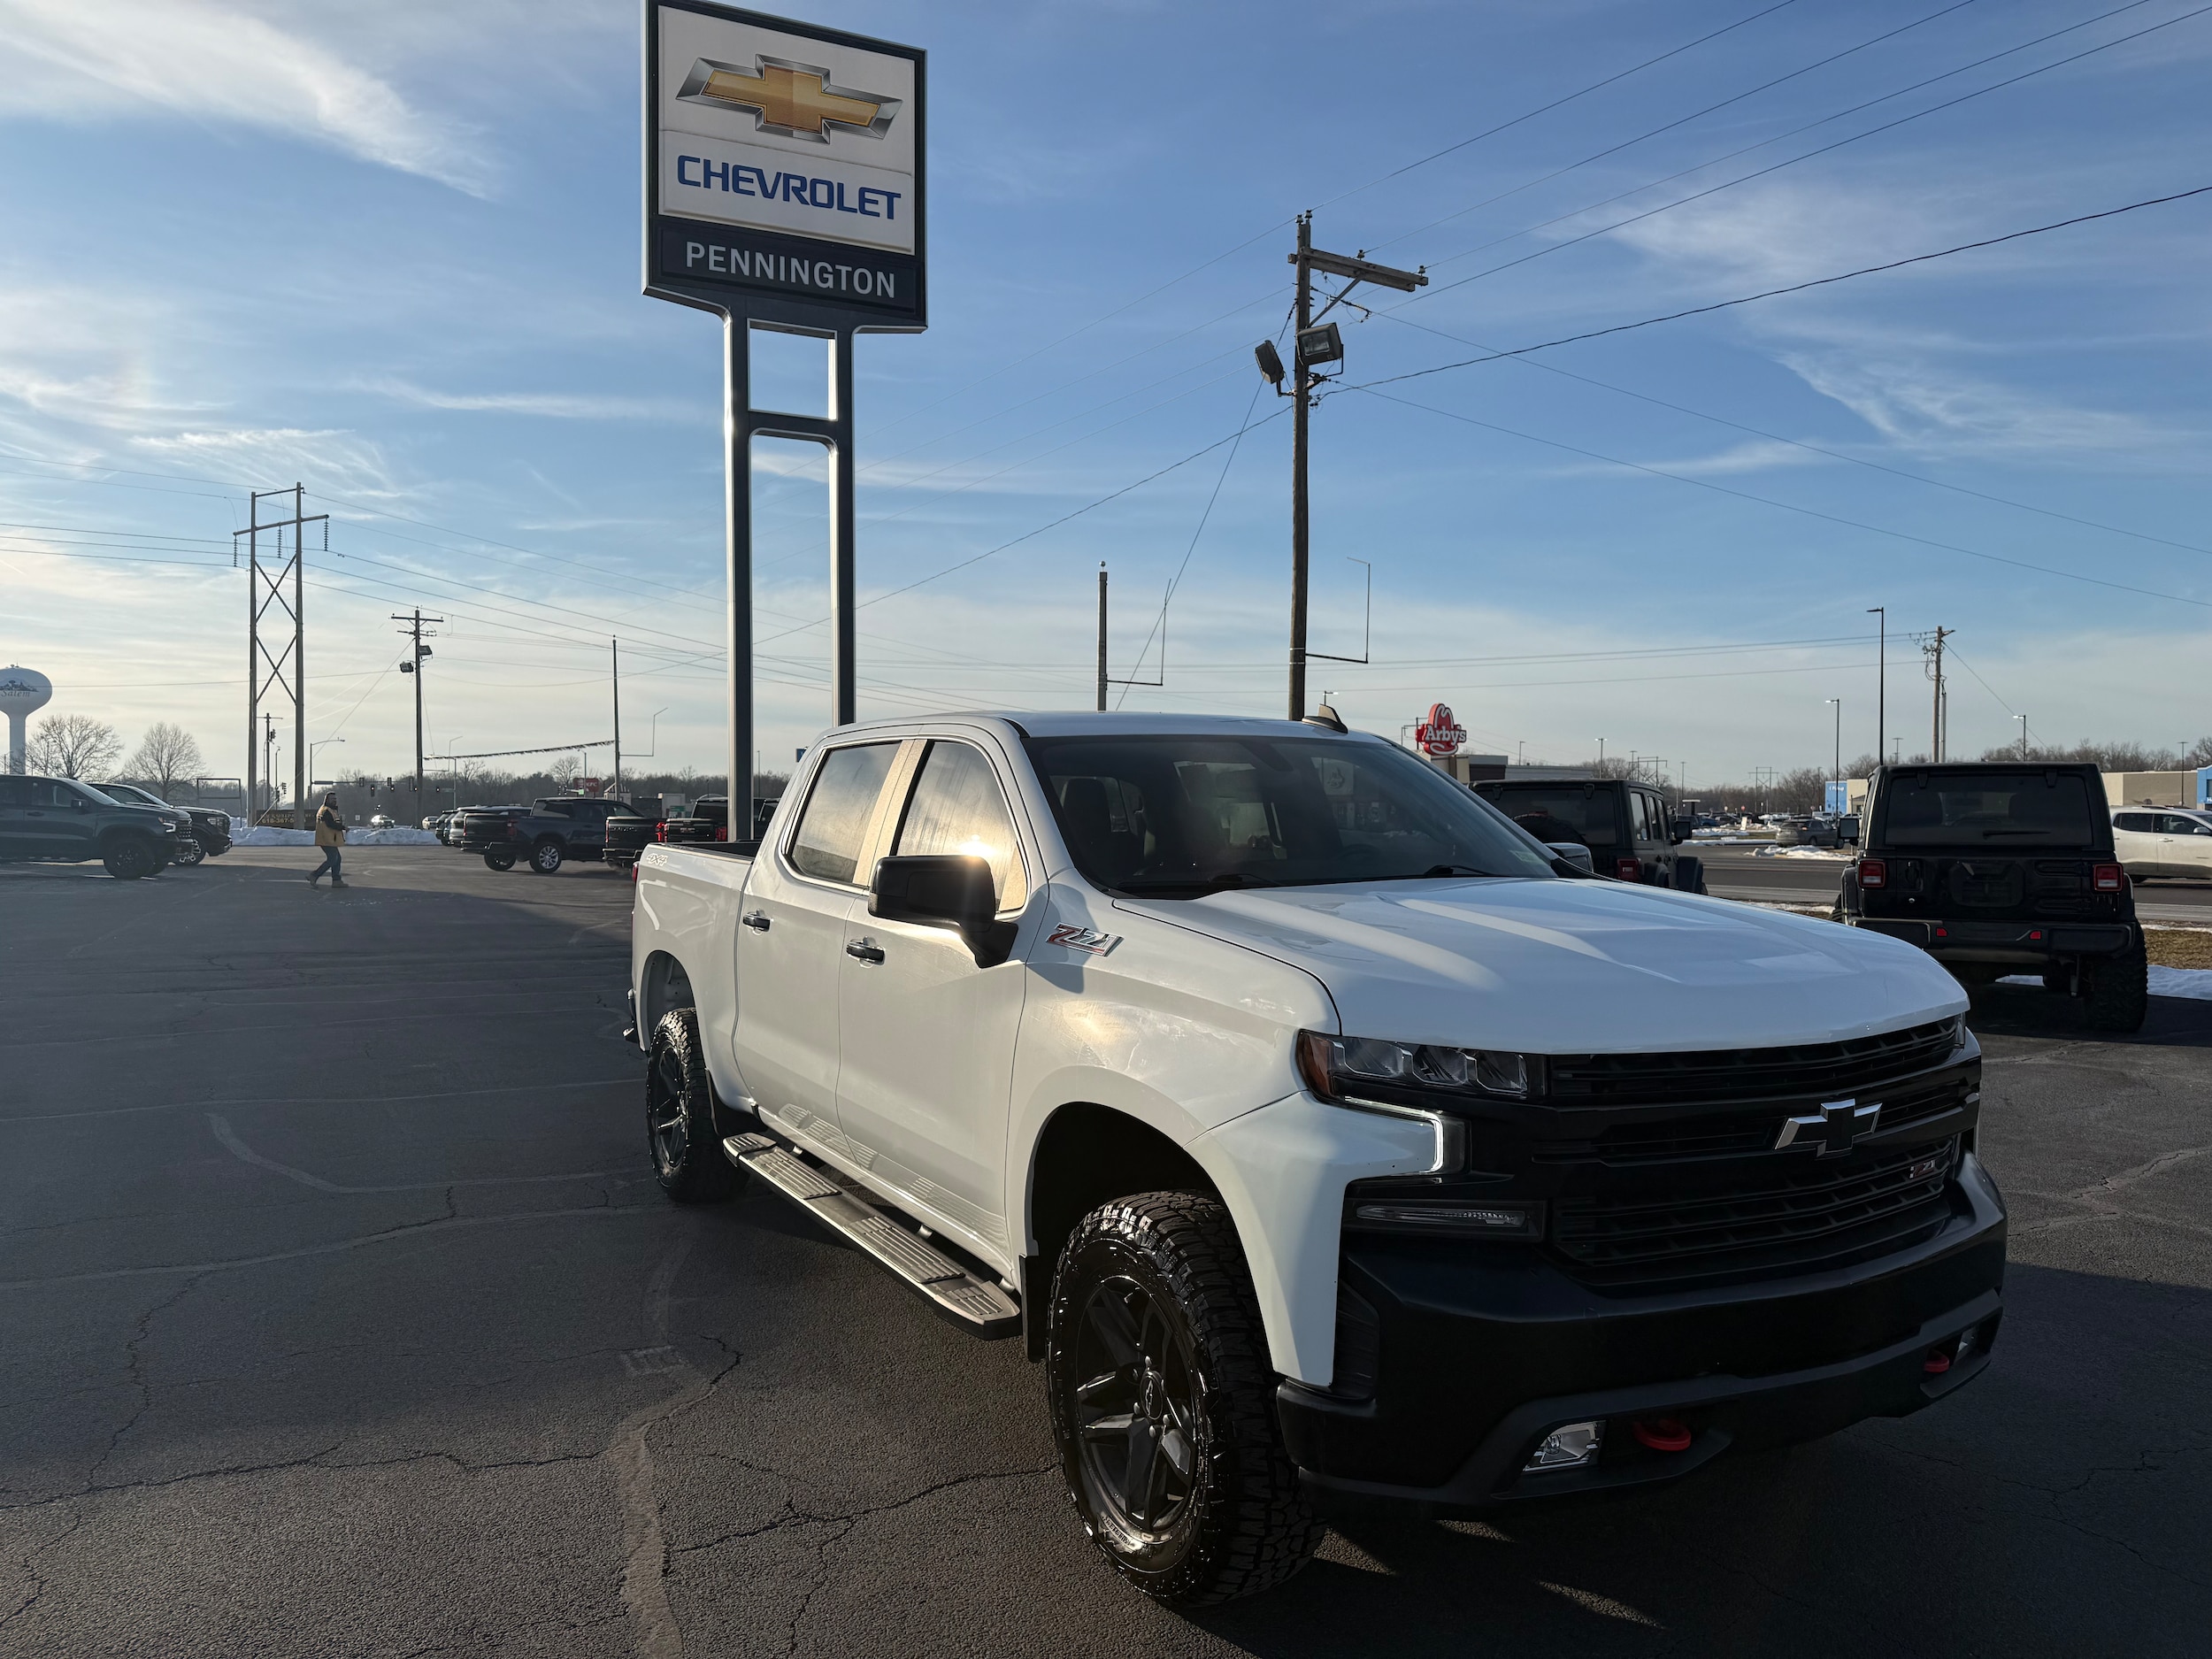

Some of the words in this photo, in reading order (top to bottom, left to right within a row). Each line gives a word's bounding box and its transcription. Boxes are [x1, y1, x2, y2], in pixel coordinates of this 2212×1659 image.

[677, 155, 902, 220] CHEVROLET
[686, 241, 895, 299] PENNINGTON
[1425, 726, 1466, 746] Arby's
[1046, 922, 1124, 957] Z71
